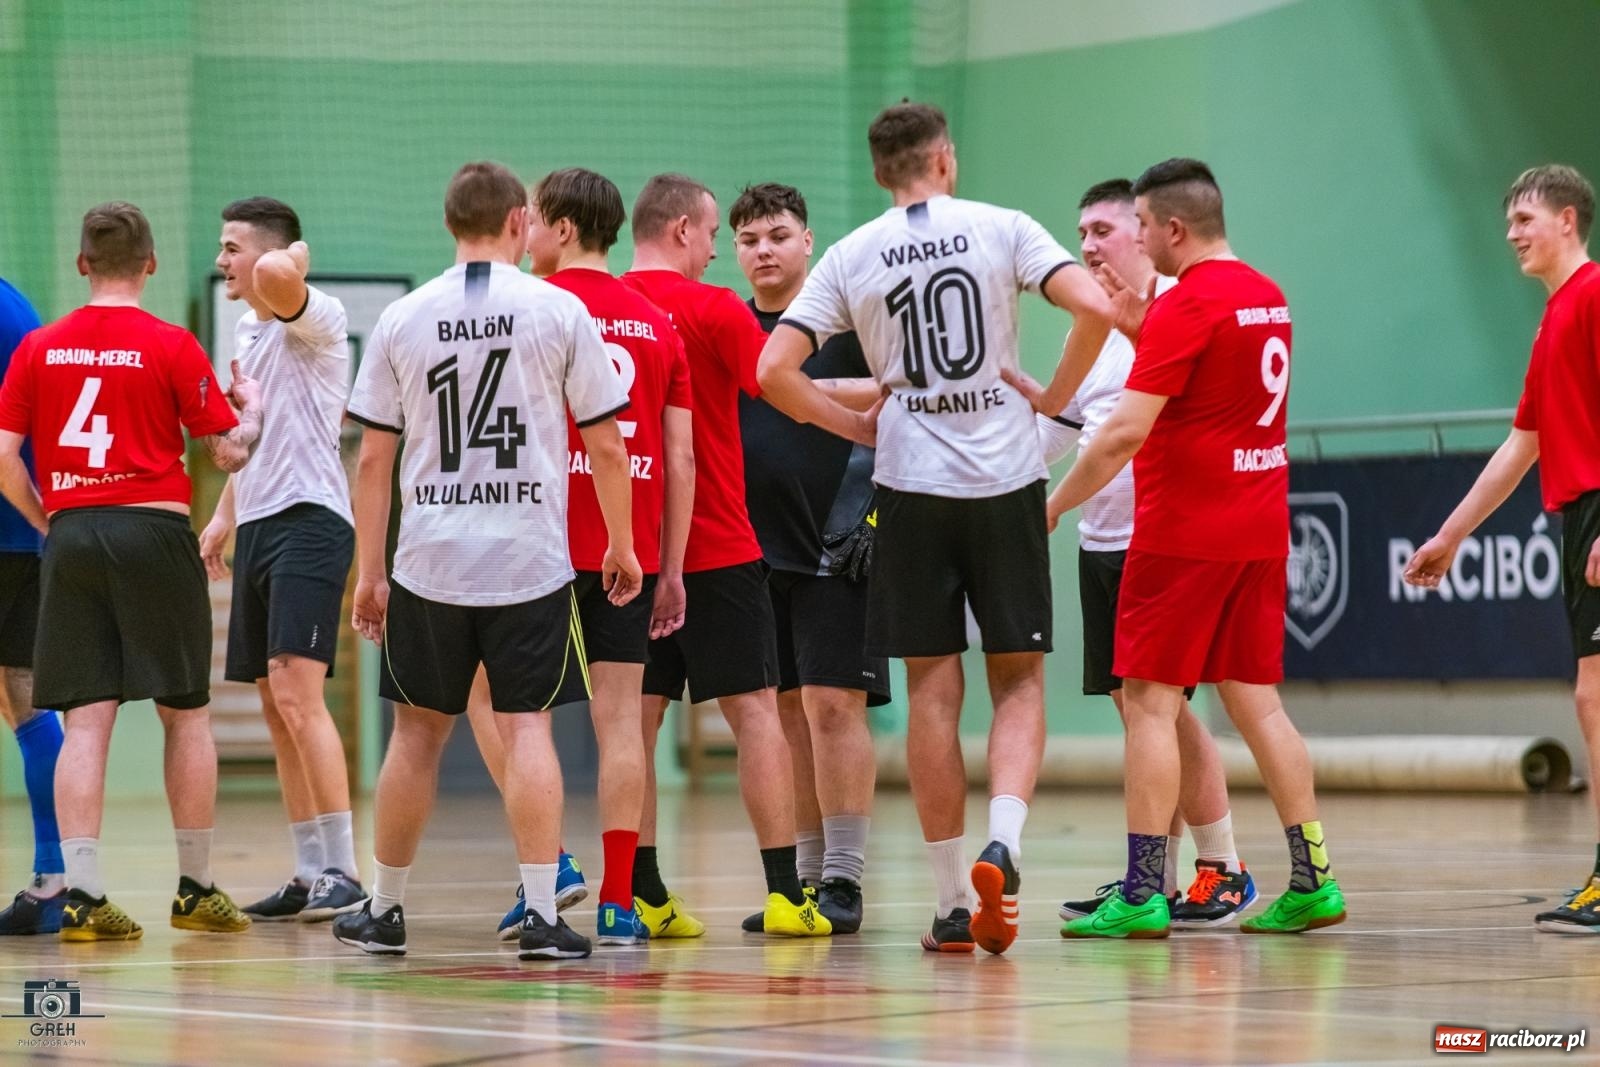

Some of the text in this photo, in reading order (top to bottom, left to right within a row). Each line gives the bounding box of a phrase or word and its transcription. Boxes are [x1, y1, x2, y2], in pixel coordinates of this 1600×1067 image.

[881, 235, 969, 268] WARŁO
[45, 348, 144, 368] BRAUN-MEBEL
[437, 314, 514, 342] BALöN
[885, 267, 985, 389] 10
[58, 377, 115, 469] 4
[427, 347, 527, 473] 14
[1256, 336, 1290, 427] 9
[517, 482, 542, 504] FC
[1388, 512, 1561, 602] RCIBÓ
